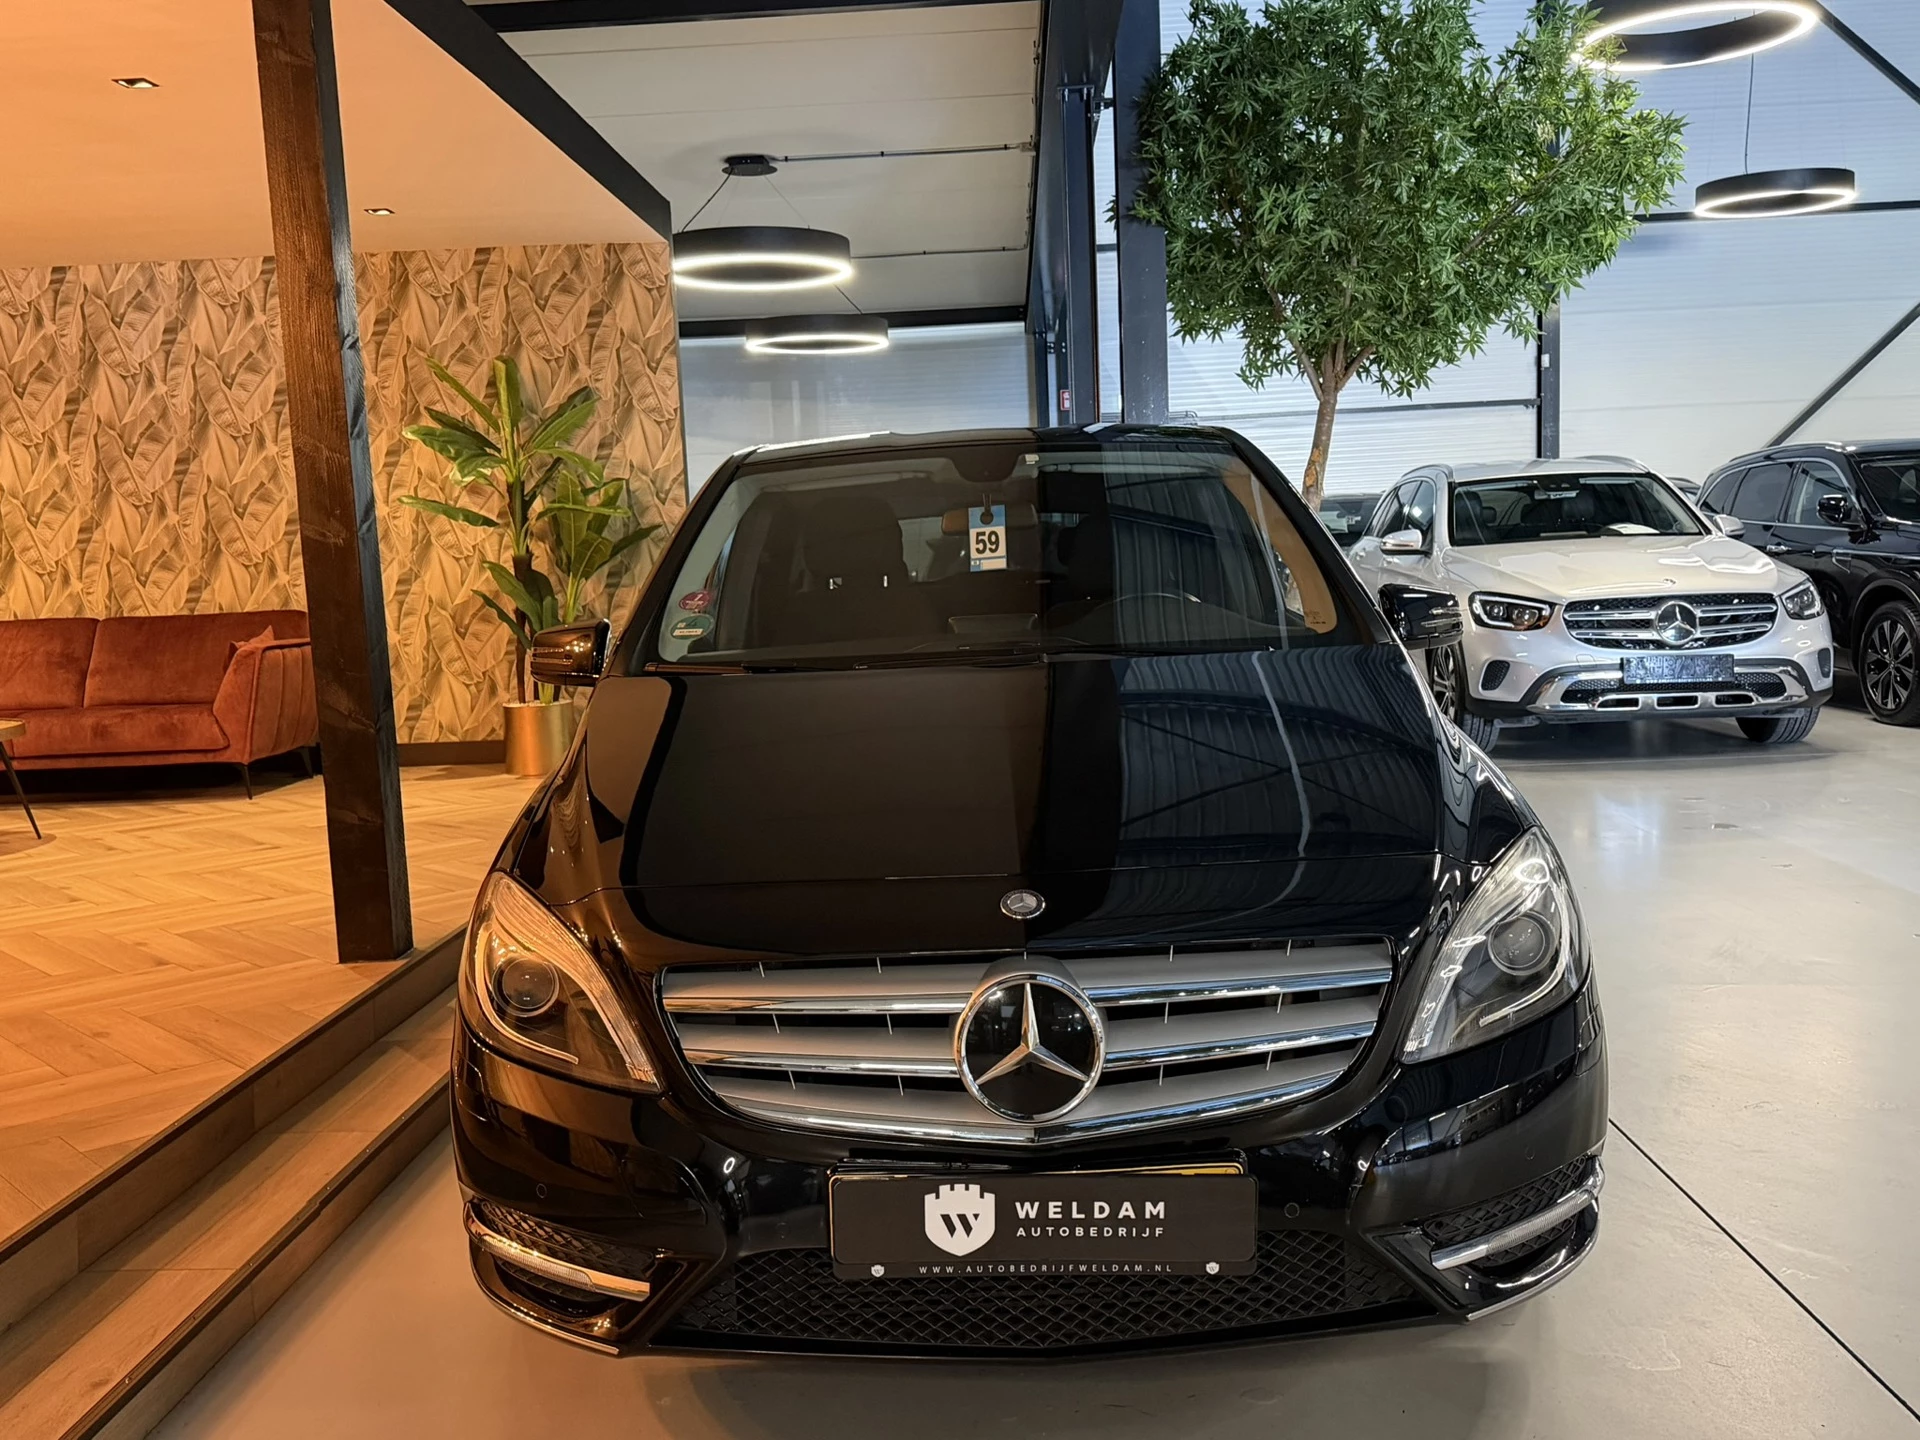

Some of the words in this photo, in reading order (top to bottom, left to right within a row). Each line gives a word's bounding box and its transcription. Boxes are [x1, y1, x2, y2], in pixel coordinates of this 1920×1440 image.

[975, 530, 1000, 555] 59
[1014, 1201, 1166, 1220] WELDAM
[940, 1213, 981, 1239] W
[1016, 1226, 1165, 1238] AUTOBEDRIJF
[919, 1263, 1172, 1274] WWW.AUTOBEDRIJFWELDAM.NL
